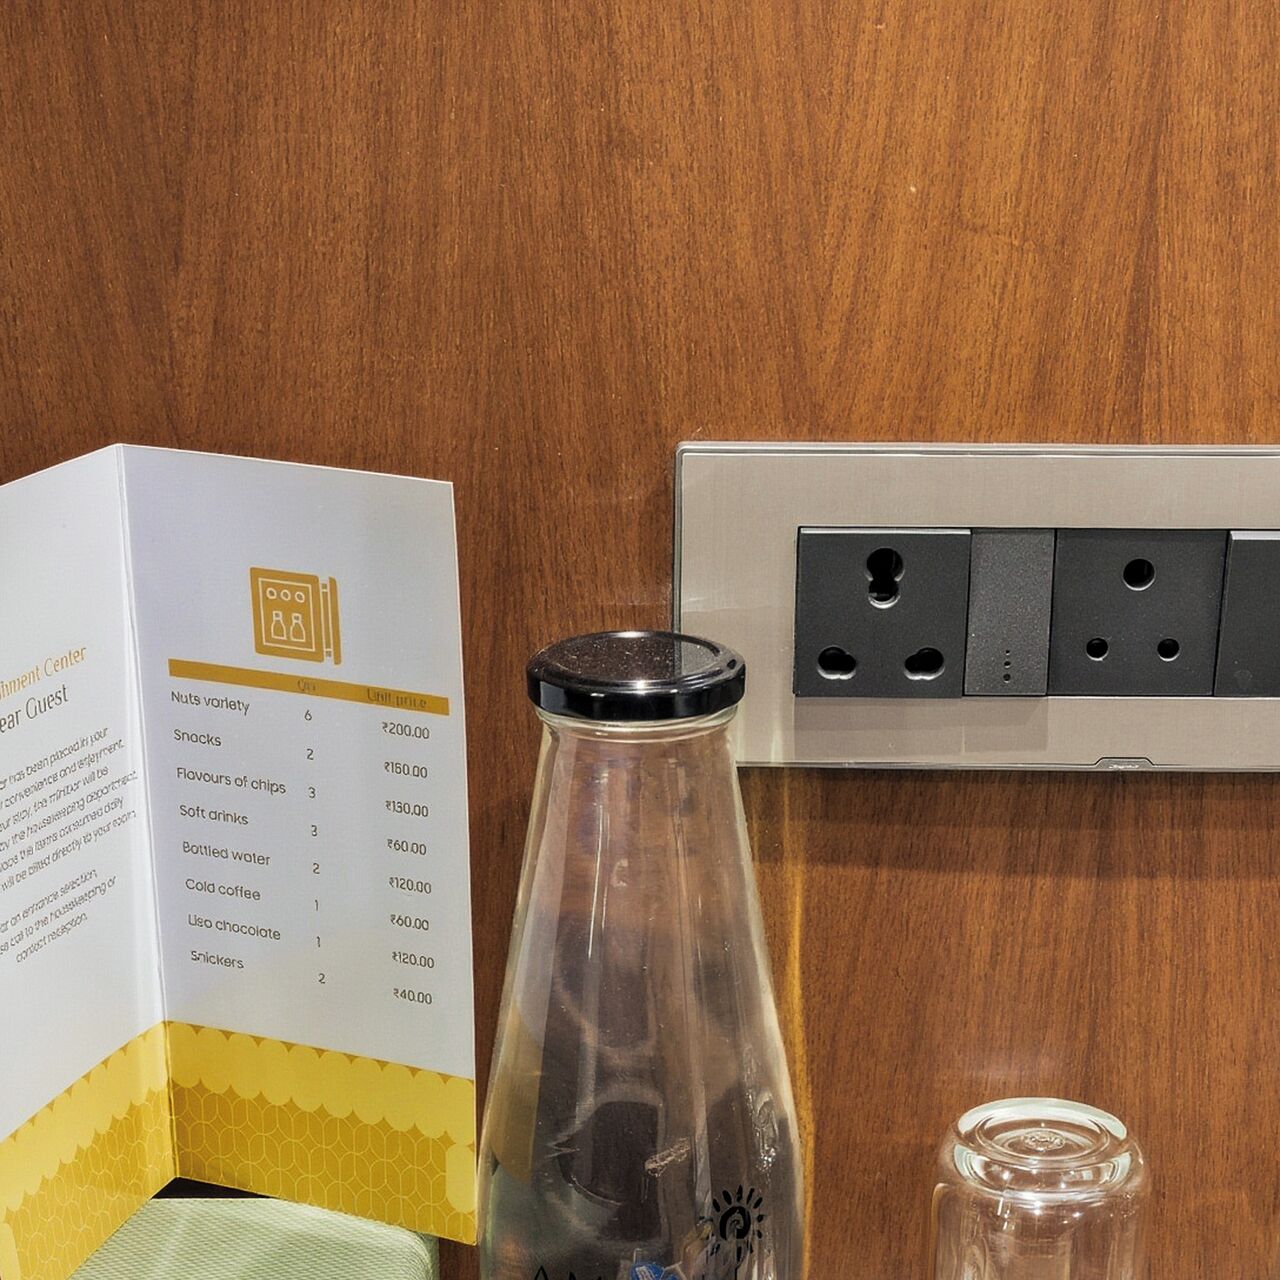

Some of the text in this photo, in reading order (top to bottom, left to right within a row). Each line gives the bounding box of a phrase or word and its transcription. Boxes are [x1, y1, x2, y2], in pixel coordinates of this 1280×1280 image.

[44, 647, 86, 677] Center
[25, 684, 68, 720] Guest
[171, 690, 430, 740] Nuts variety 6 ₹200.00
[173, 728, 222, 747] Snacks
[306, 748, 314, 760] 2
[176, 767, 231, 786] Flavours
[234, 776, 248, 788] of
[251, 779, 286, 796] chips
[308, 787, 316, 799] 3
[179, 804, 206, 819] Soft
[208, 809, 249, 826] drinks
[311, 824, 318, 837] 3
[183, 841, 229, 859] Bottled
[232, 850, 271, 866] water
[312, 862, 320, 875] 2
[186, 878, 216, 894] Cold
[218, 885, 261, 901] coffee
[314, 899, 319, 911] 1
[215, 919, 281, 941] chocolate
[316, 936, 321, 948] 1
[191, 950, 245, 970] Snickers
[318, 972, 326, 985] 2
